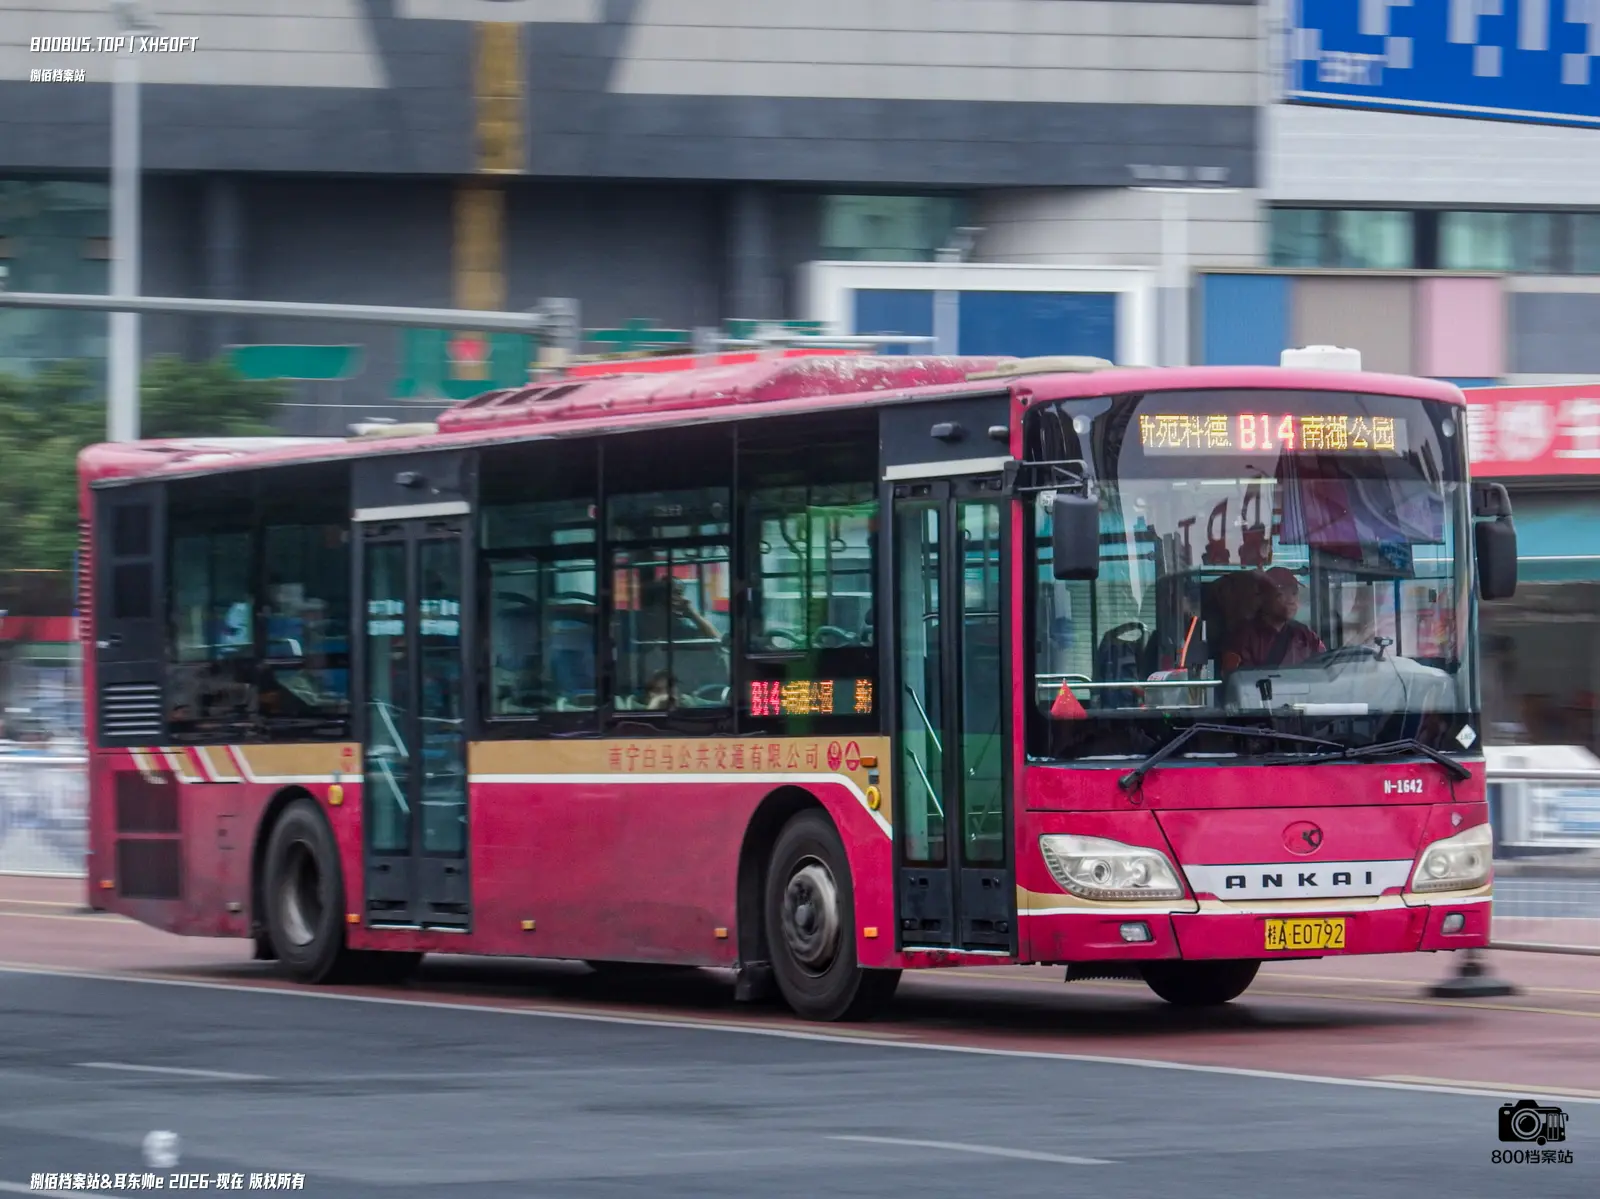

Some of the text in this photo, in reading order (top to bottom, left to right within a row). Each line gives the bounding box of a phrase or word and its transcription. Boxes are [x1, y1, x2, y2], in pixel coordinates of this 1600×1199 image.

[1239, 413, 1295, 450] B14
[1301, 414, 1395, 450] 南湖公园
[608, 743, 820, 772] 南宁白马公共交通有限公司
[1384, 779, 1423, 794] N-1642
[1225, 871, 1373, 889] ANKAI
